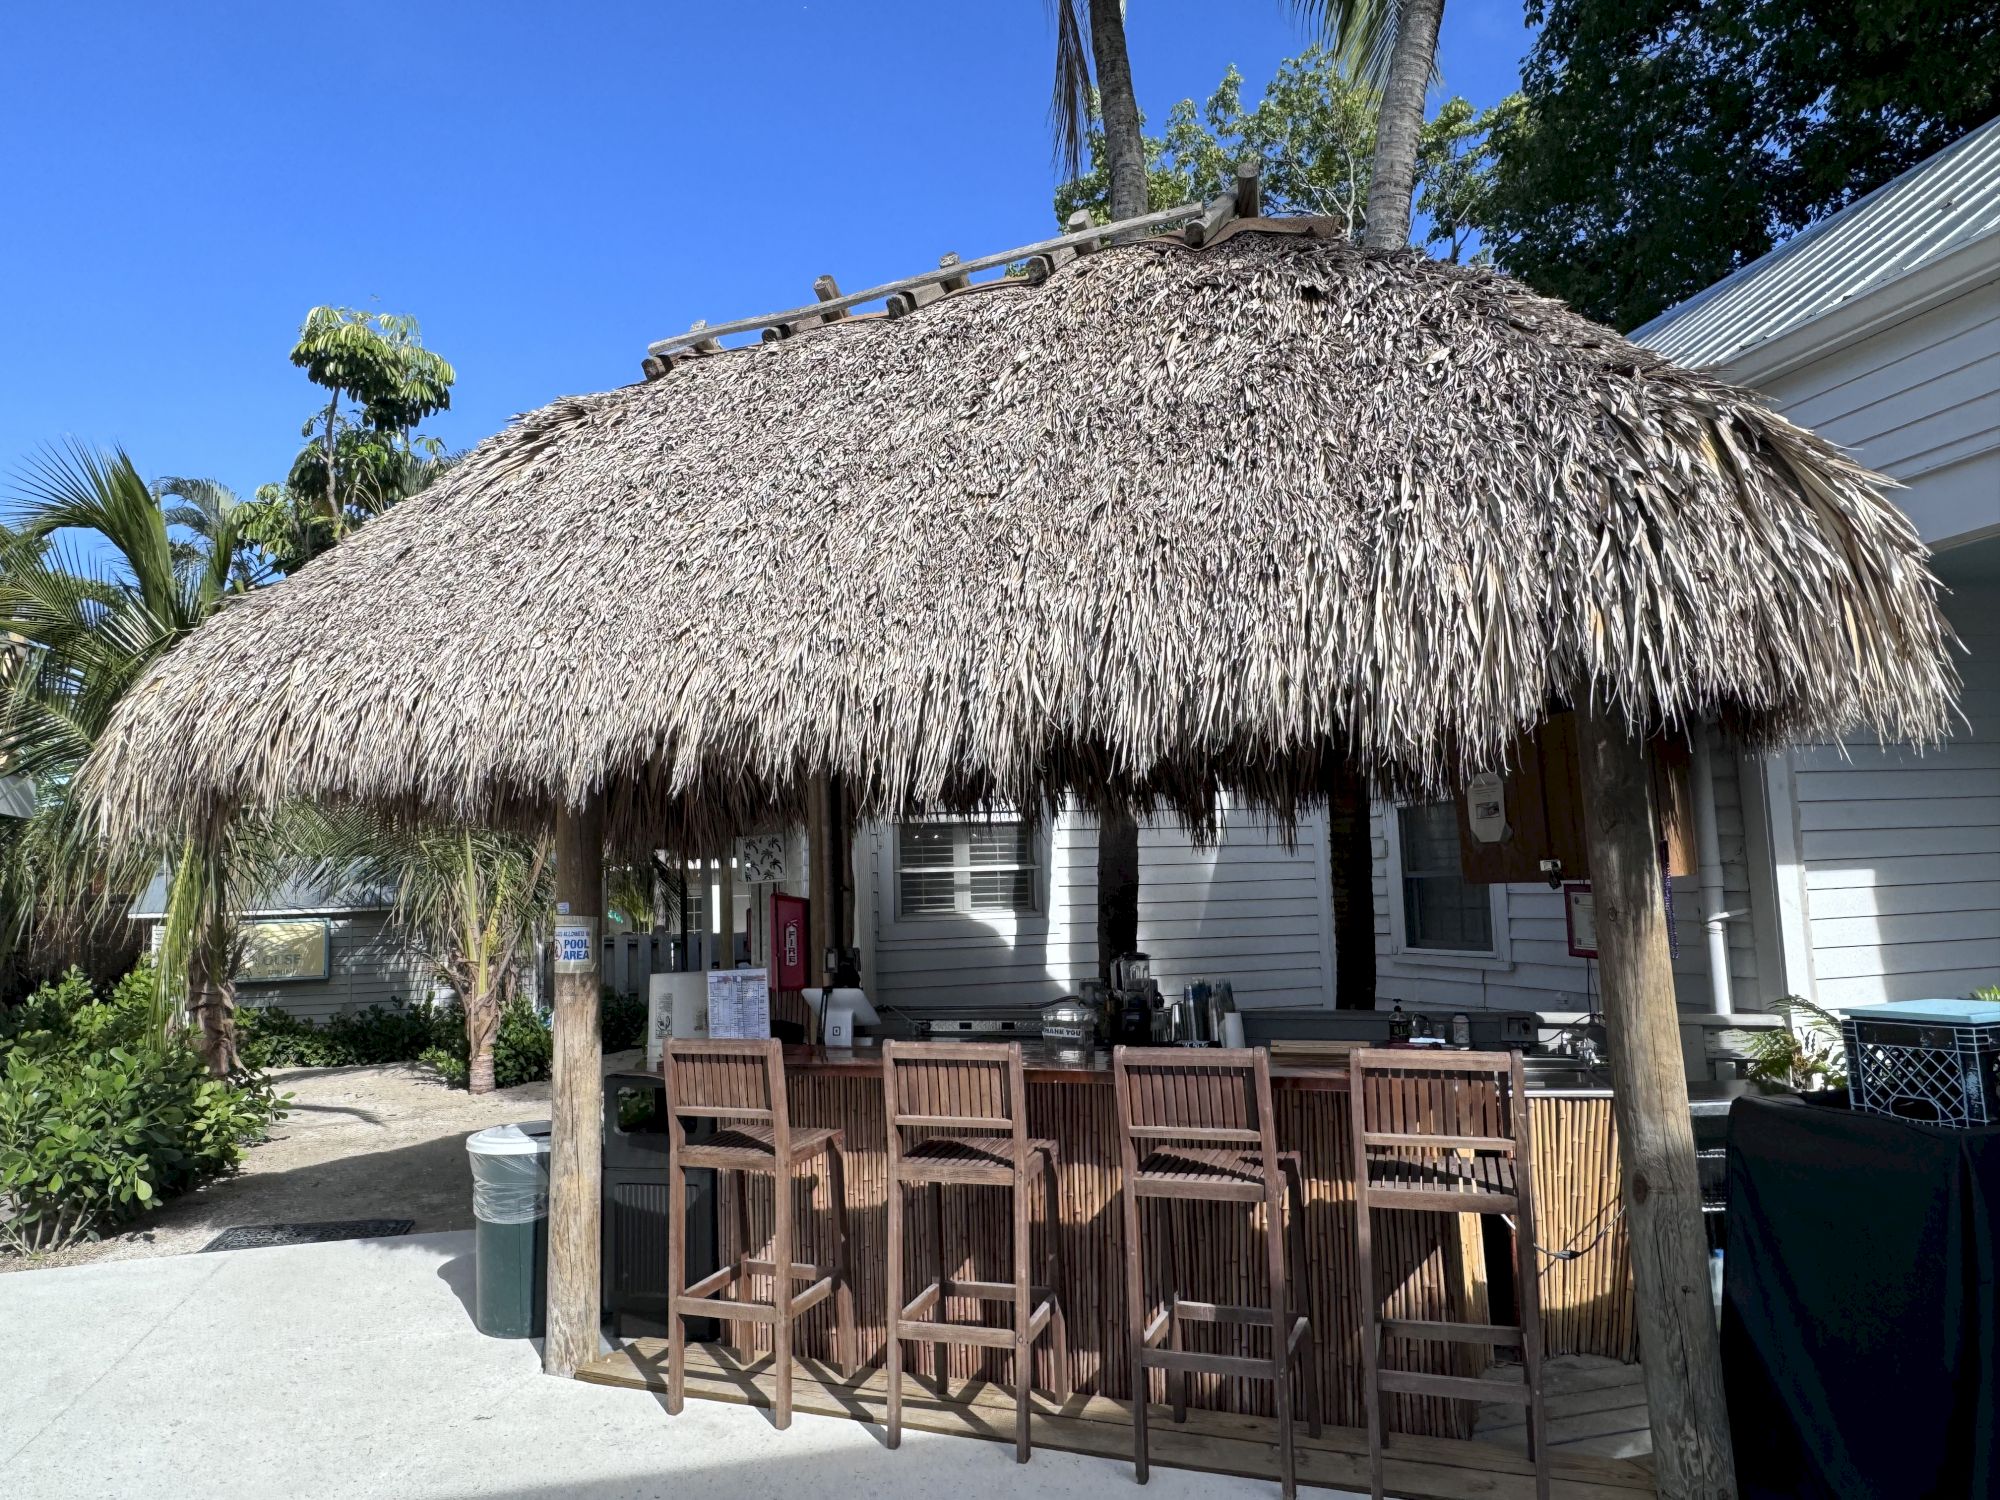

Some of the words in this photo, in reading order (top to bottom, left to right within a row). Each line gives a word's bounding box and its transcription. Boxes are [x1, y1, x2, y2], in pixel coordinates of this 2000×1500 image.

[564, 939, 590, 949] POOL
[788, 930, 796, 963] FIRE
[257, 953, 301, 966] OUSE
[563, 950, 590, 960] AREA
[1066, 1029, 1081, 1037] YOU
